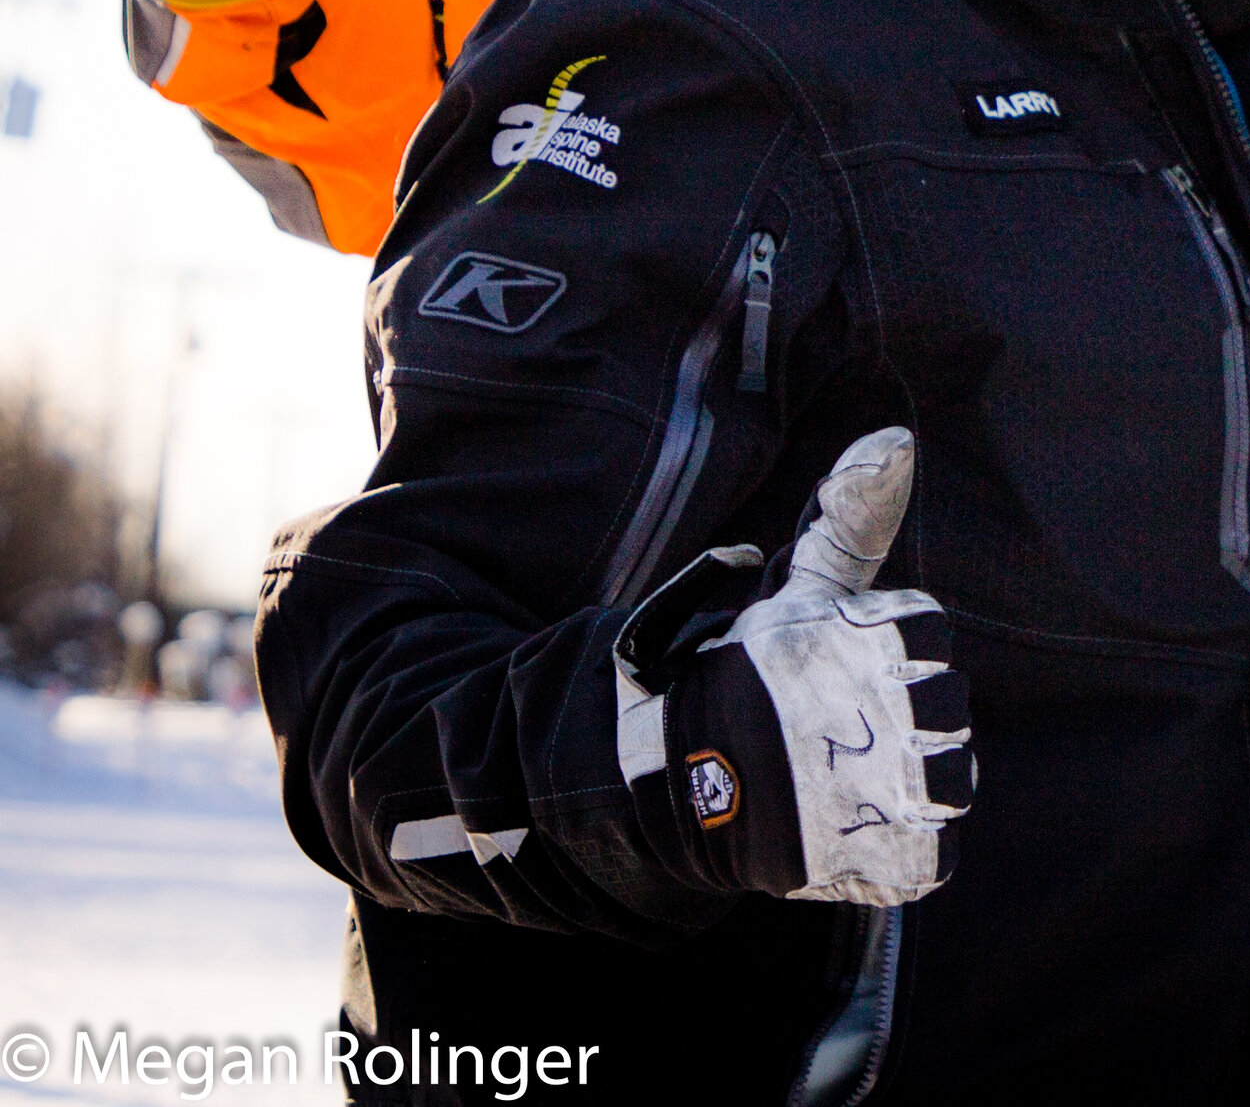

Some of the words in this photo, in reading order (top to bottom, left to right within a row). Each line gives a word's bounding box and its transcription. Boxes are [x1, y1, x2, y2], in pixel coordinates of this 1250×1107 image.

[549, 129, 601, 158] spine
[562, 111, 622, 145] alaska
[540, 144, 618, 190] institute
[689, 766, 709, 816] HESTRA
